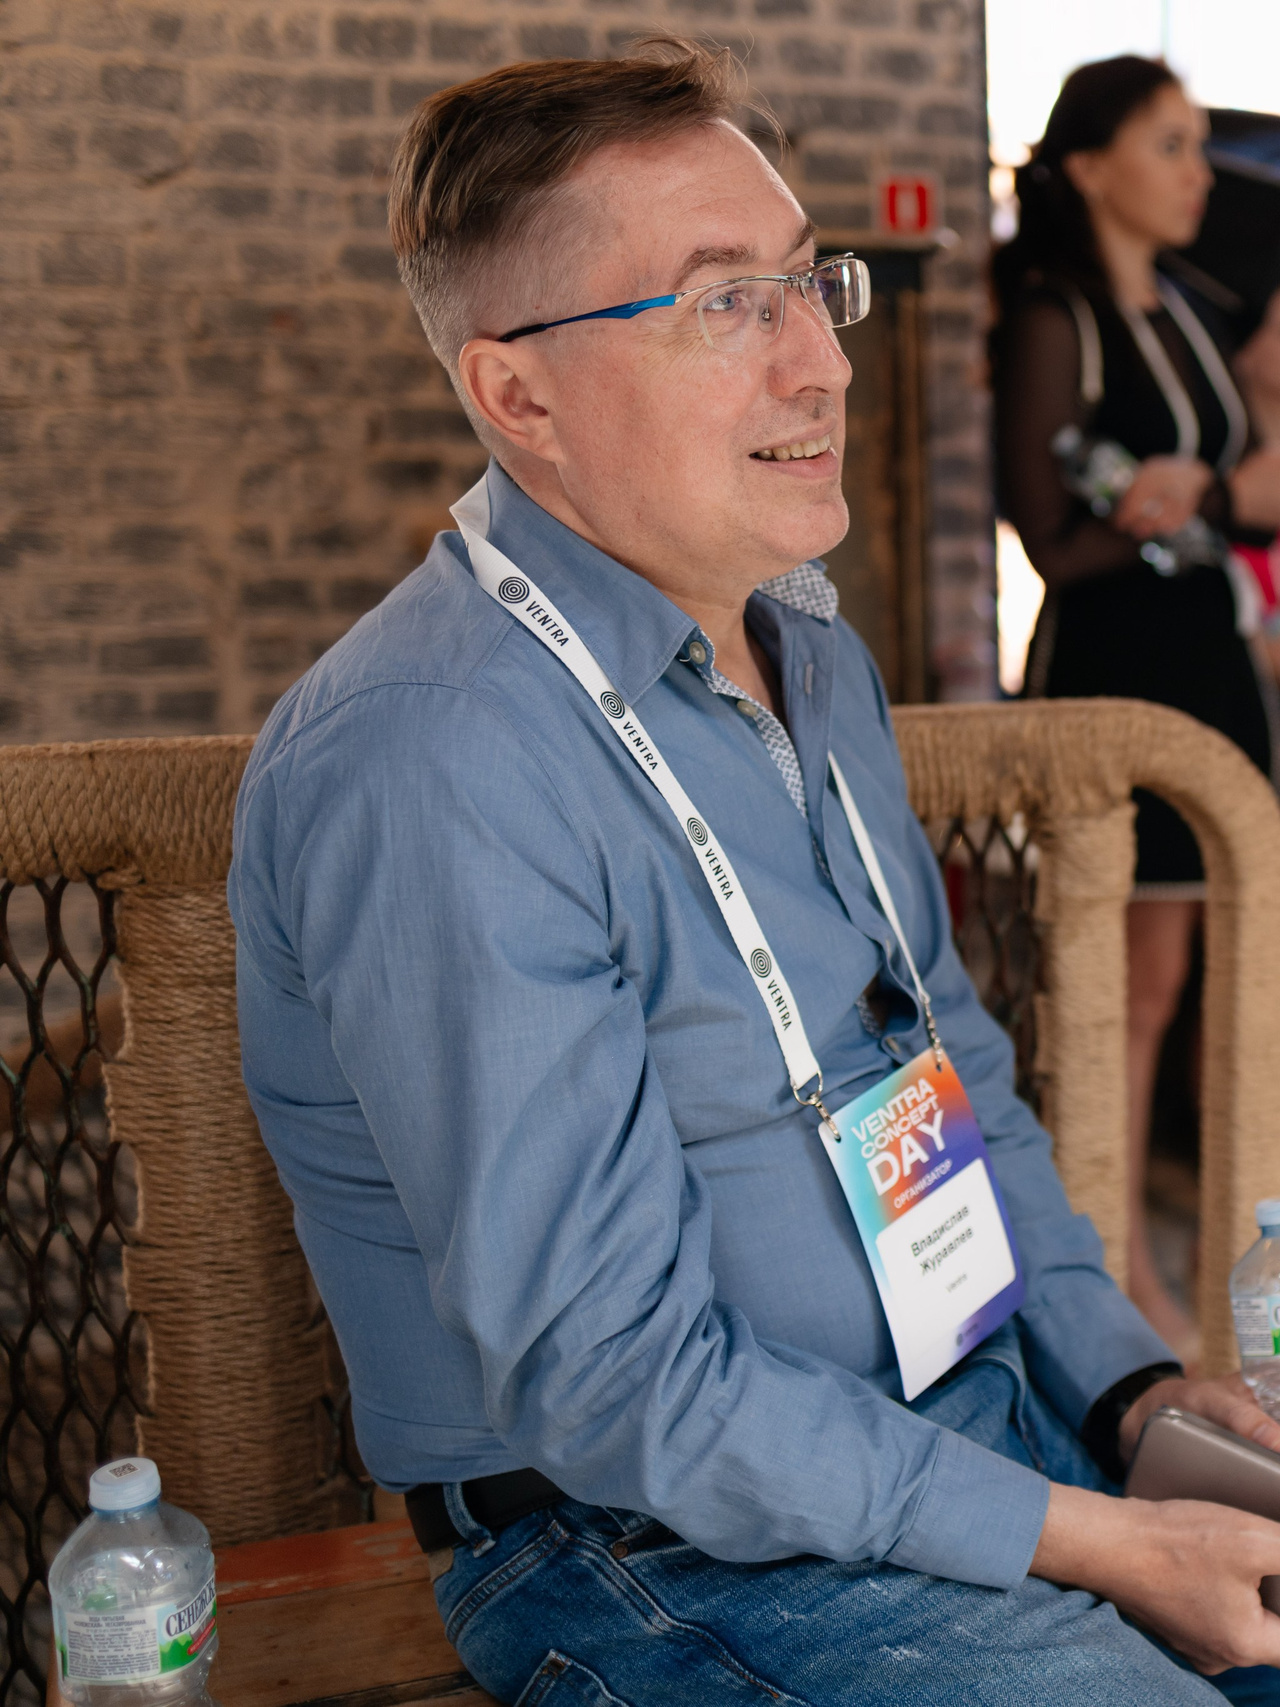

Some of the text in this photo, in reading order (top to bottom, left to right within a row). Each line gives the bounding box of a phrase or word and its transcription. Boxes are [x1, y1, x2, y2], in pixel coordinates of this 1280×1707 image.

[526, 601, 569, 647] VENTRA
[623, 721, 658, 771] VENTRA
[704, 848, 734, 901] VENTRA
[767, 979, 792, 1032] VENTRA
[852, 1077, 935, 1142] VENTRA
[861, 1095, 939, 1159] CONCEPT
[866, 1108, 946, 1195] DAY
[893, 1159, 952, 1208] ОРГАНИЗАТОР
[911, 1205, 970, 1258] Владислав
[920, 1227, 973, 1275] Журавлев
